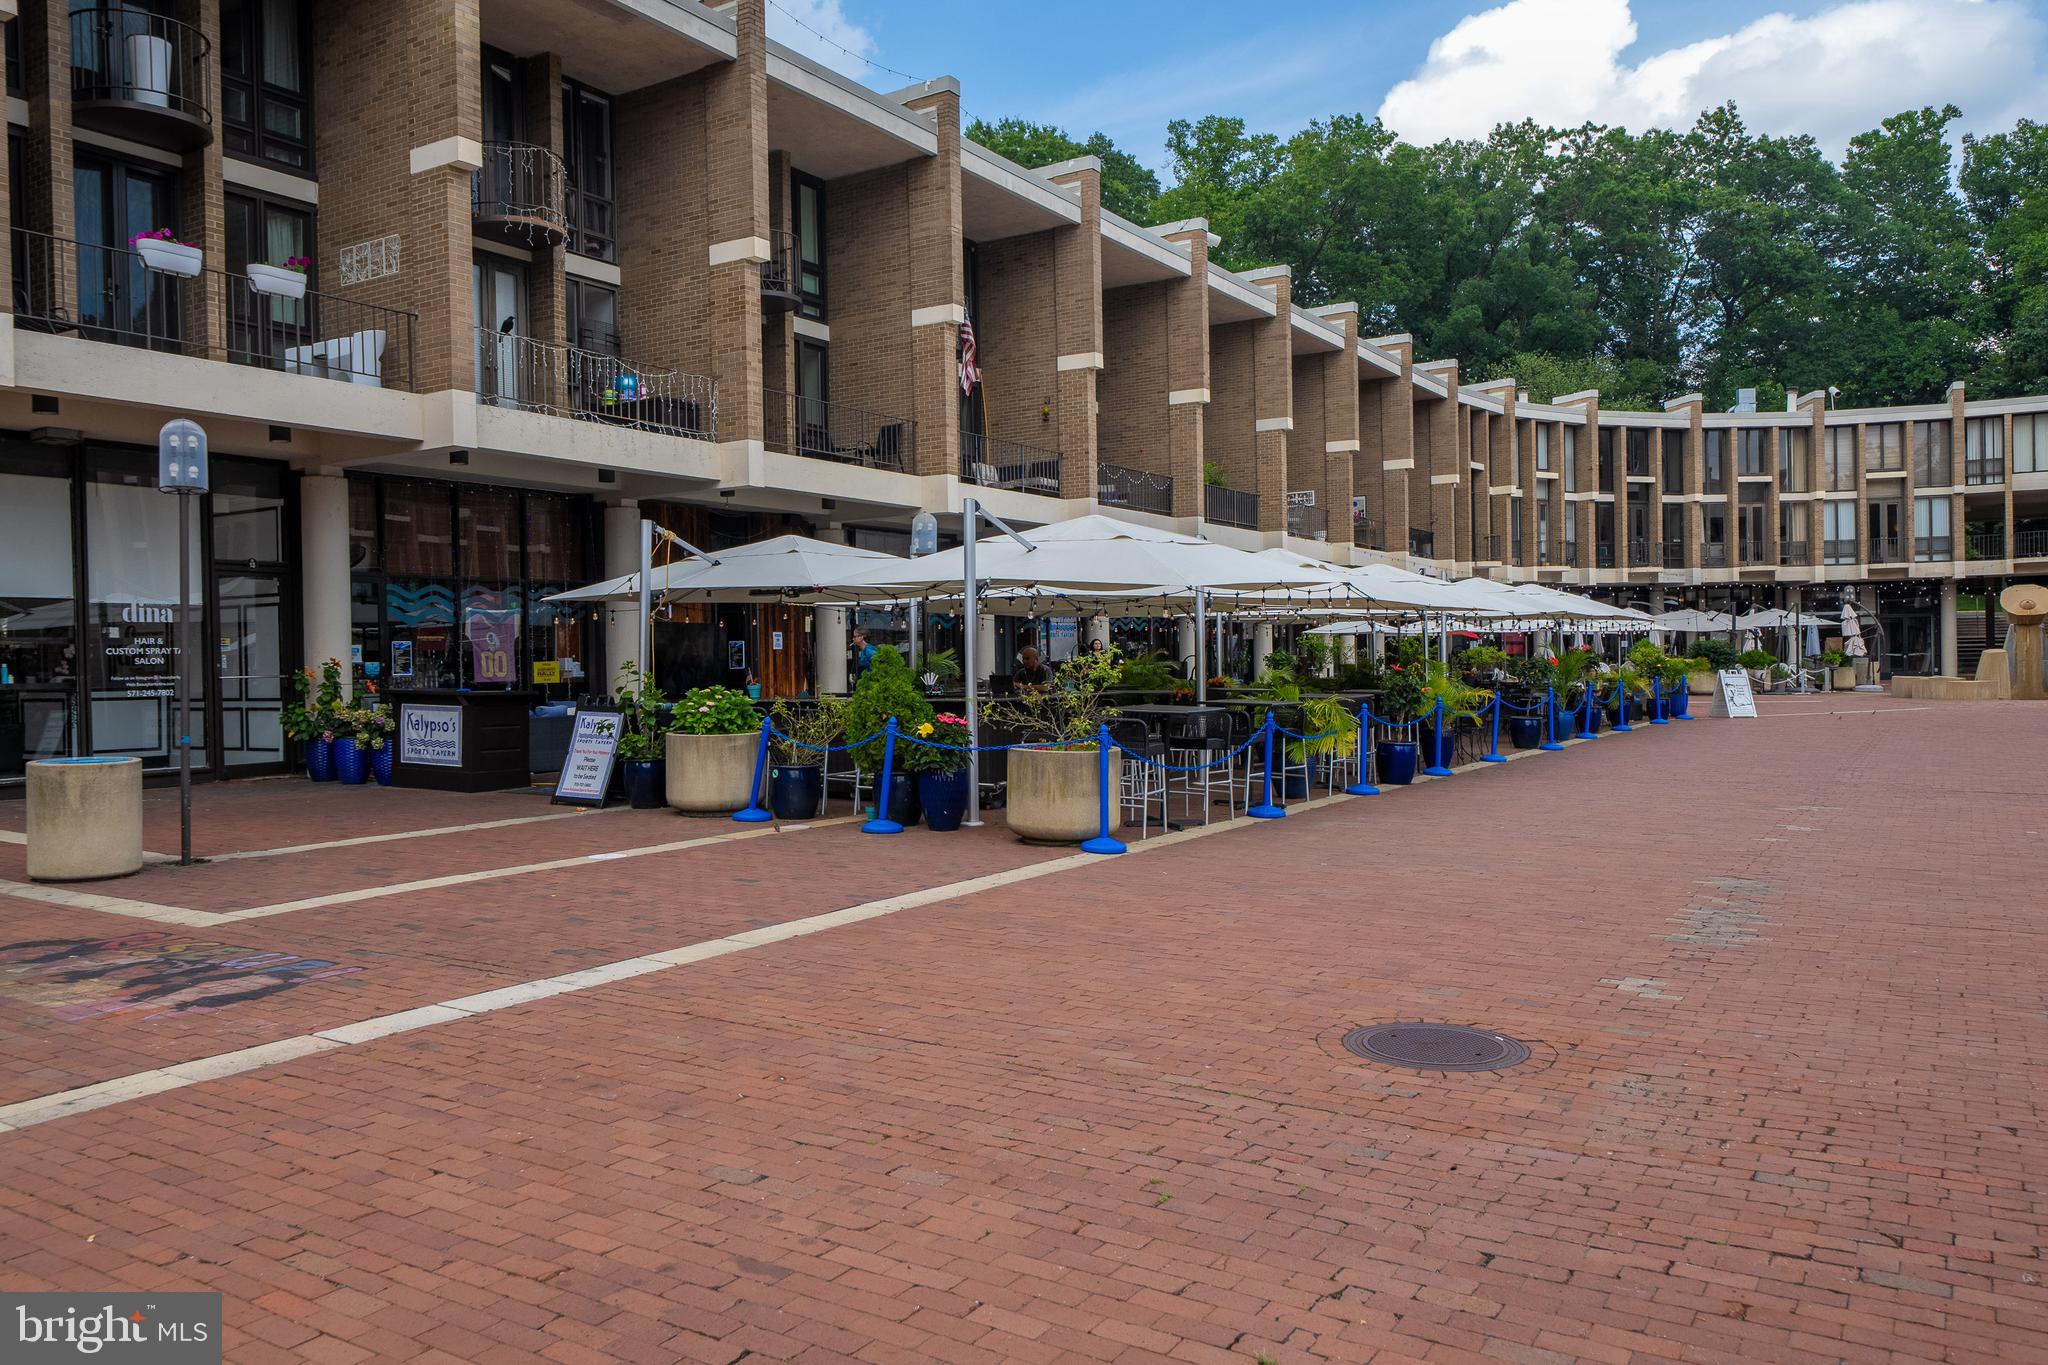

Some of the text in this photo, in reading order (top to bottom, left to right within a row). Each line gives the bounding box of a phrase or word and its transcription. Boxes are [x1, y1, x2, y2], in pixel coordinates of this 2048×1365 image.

[122, 602, 173, 623] dina
[134, 637, 164, 645] HAIR &
[105, 647, 144, 655] CUSTOM
[145, 647, 171, 655] SPRAY
[134, 657, 165, 665] SALON
[481, 651, 507, 677] 00
[127, 689, 174, 697] 571-245-7802
[407, 712, 456, 738] Kalypso's
[407, 747, 456, 757] SPORTS TAVERN
